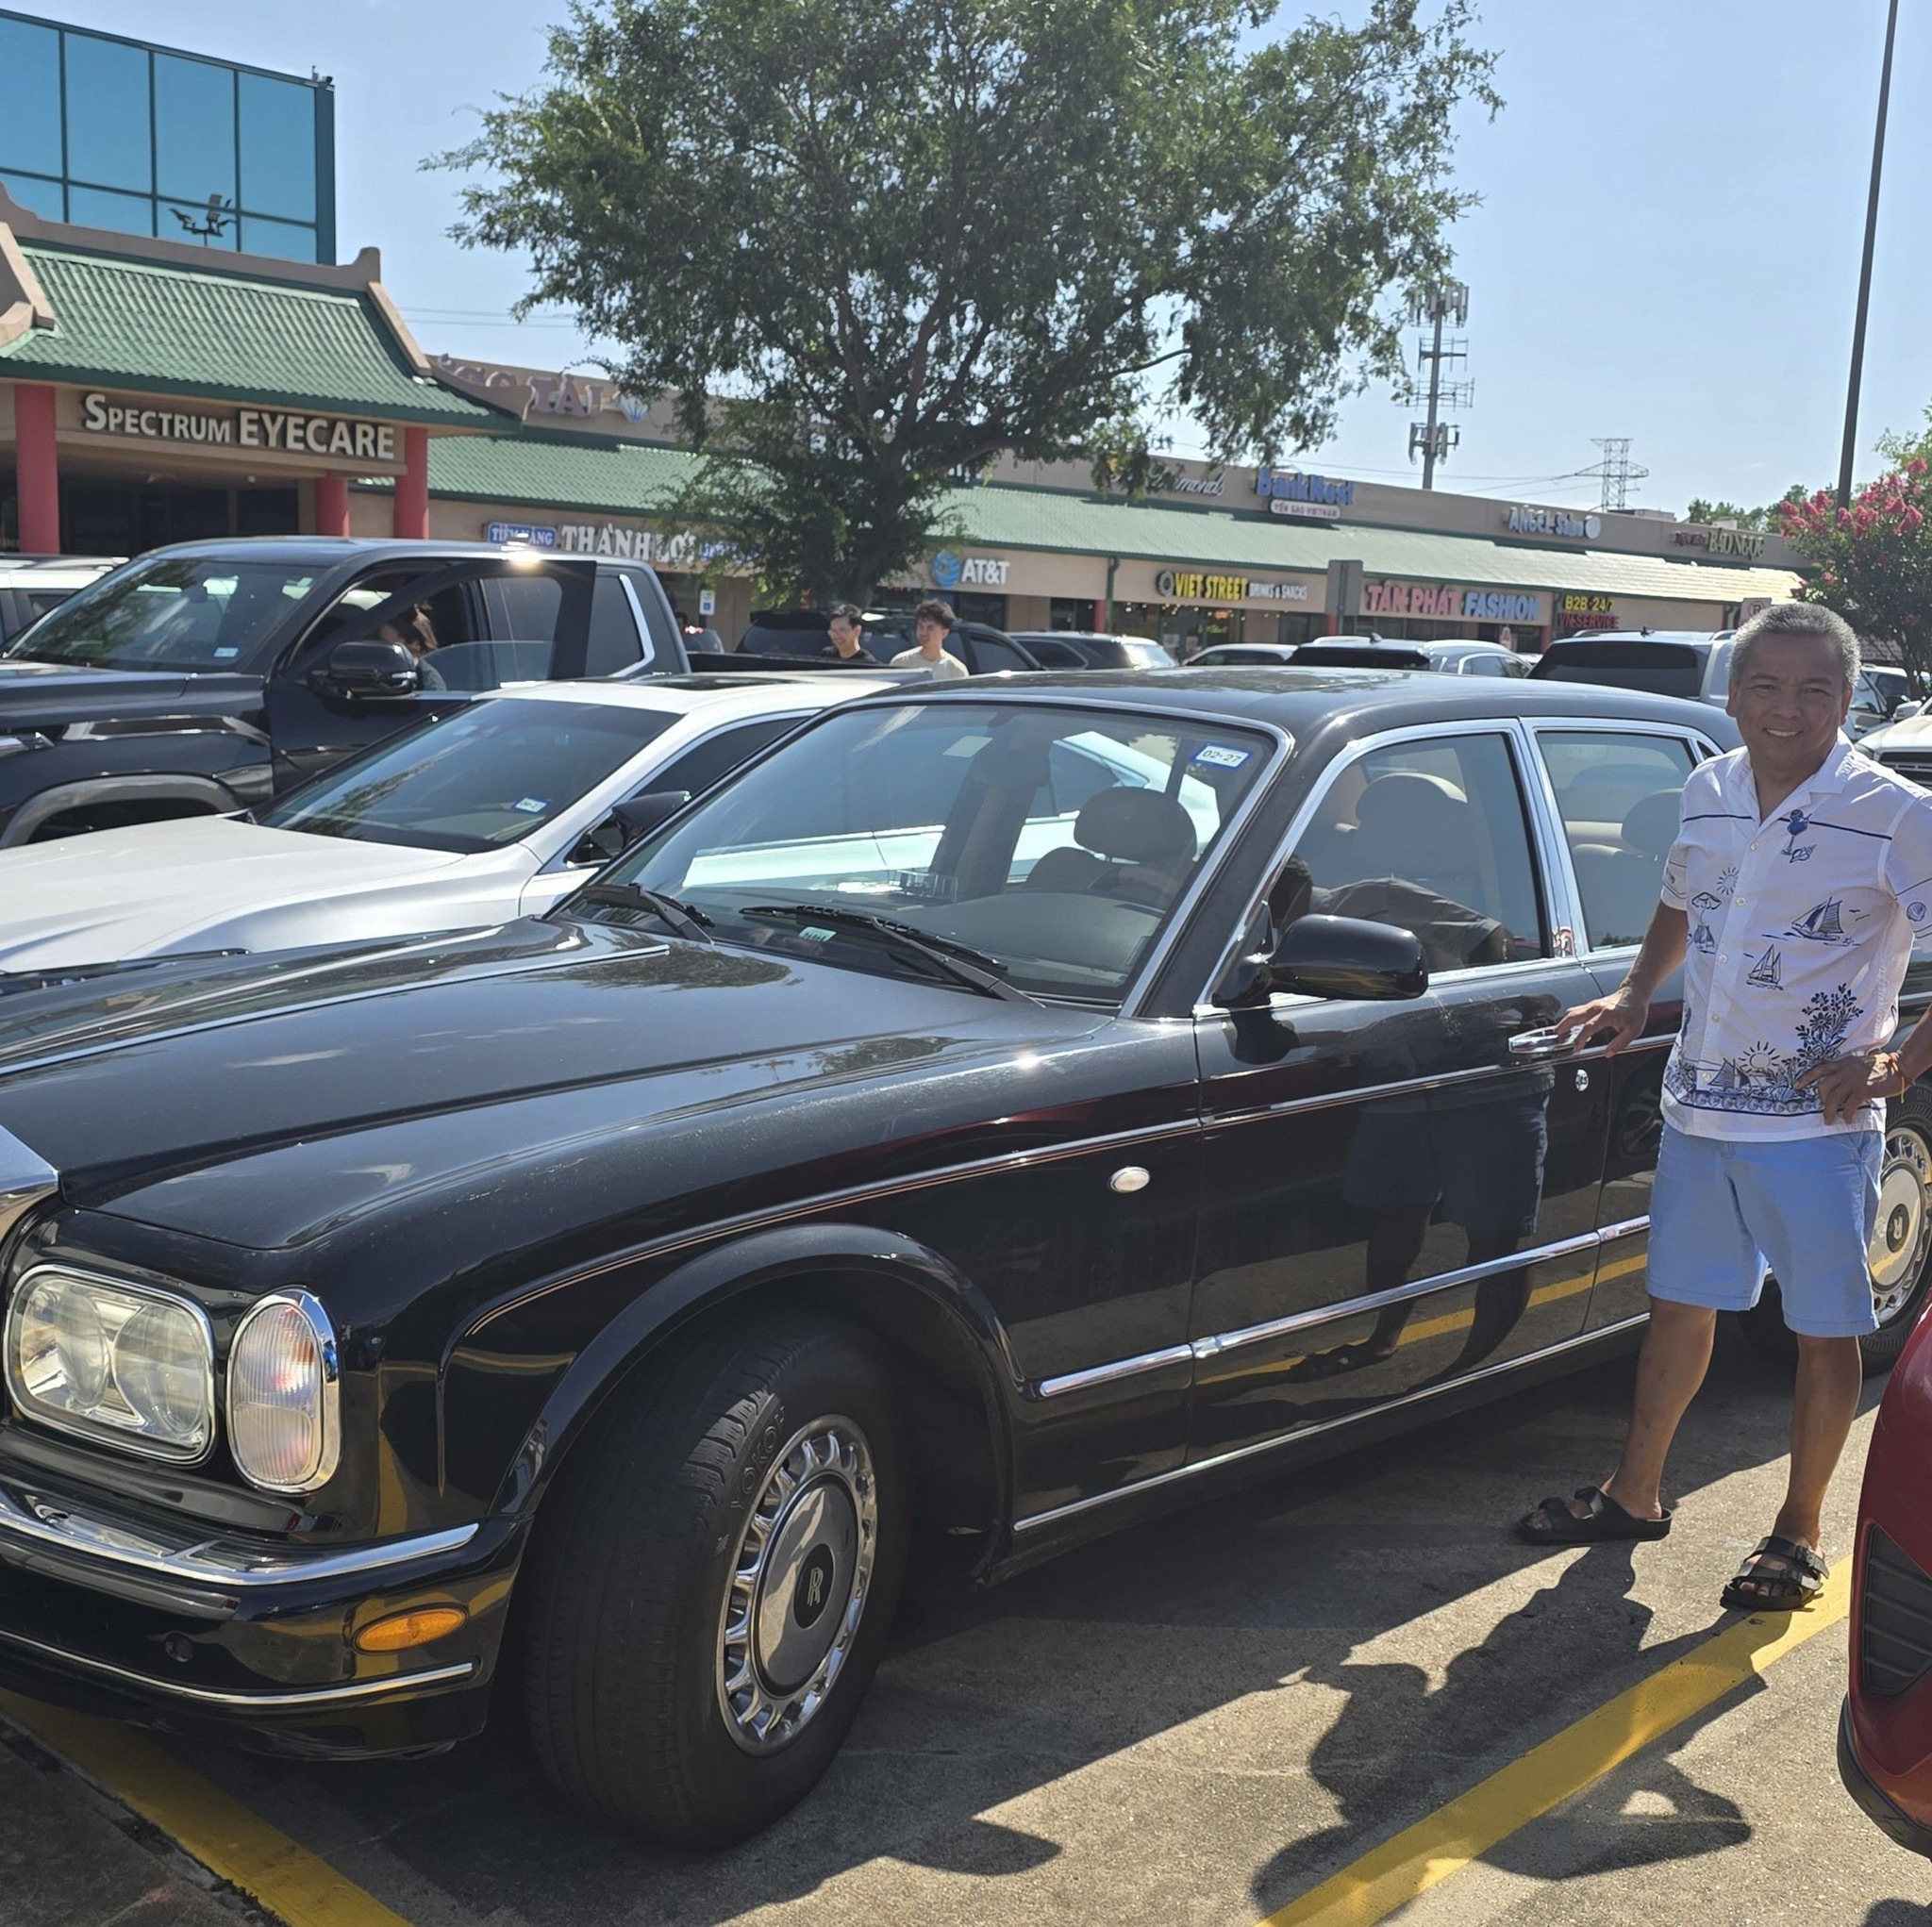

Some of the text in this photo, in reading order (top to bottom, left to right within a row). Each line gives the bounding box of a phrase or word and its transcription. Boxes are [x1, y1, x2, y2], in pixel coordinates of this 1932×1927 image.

[240, 410, 395, 460] EYECARE
[961, 557, 1010, 585] AT&T
[1175, 573, 1203, 598] VIET
[1205, 575, 1248, 601] STREET
[1464, 591, 1540, 621] FASHION
